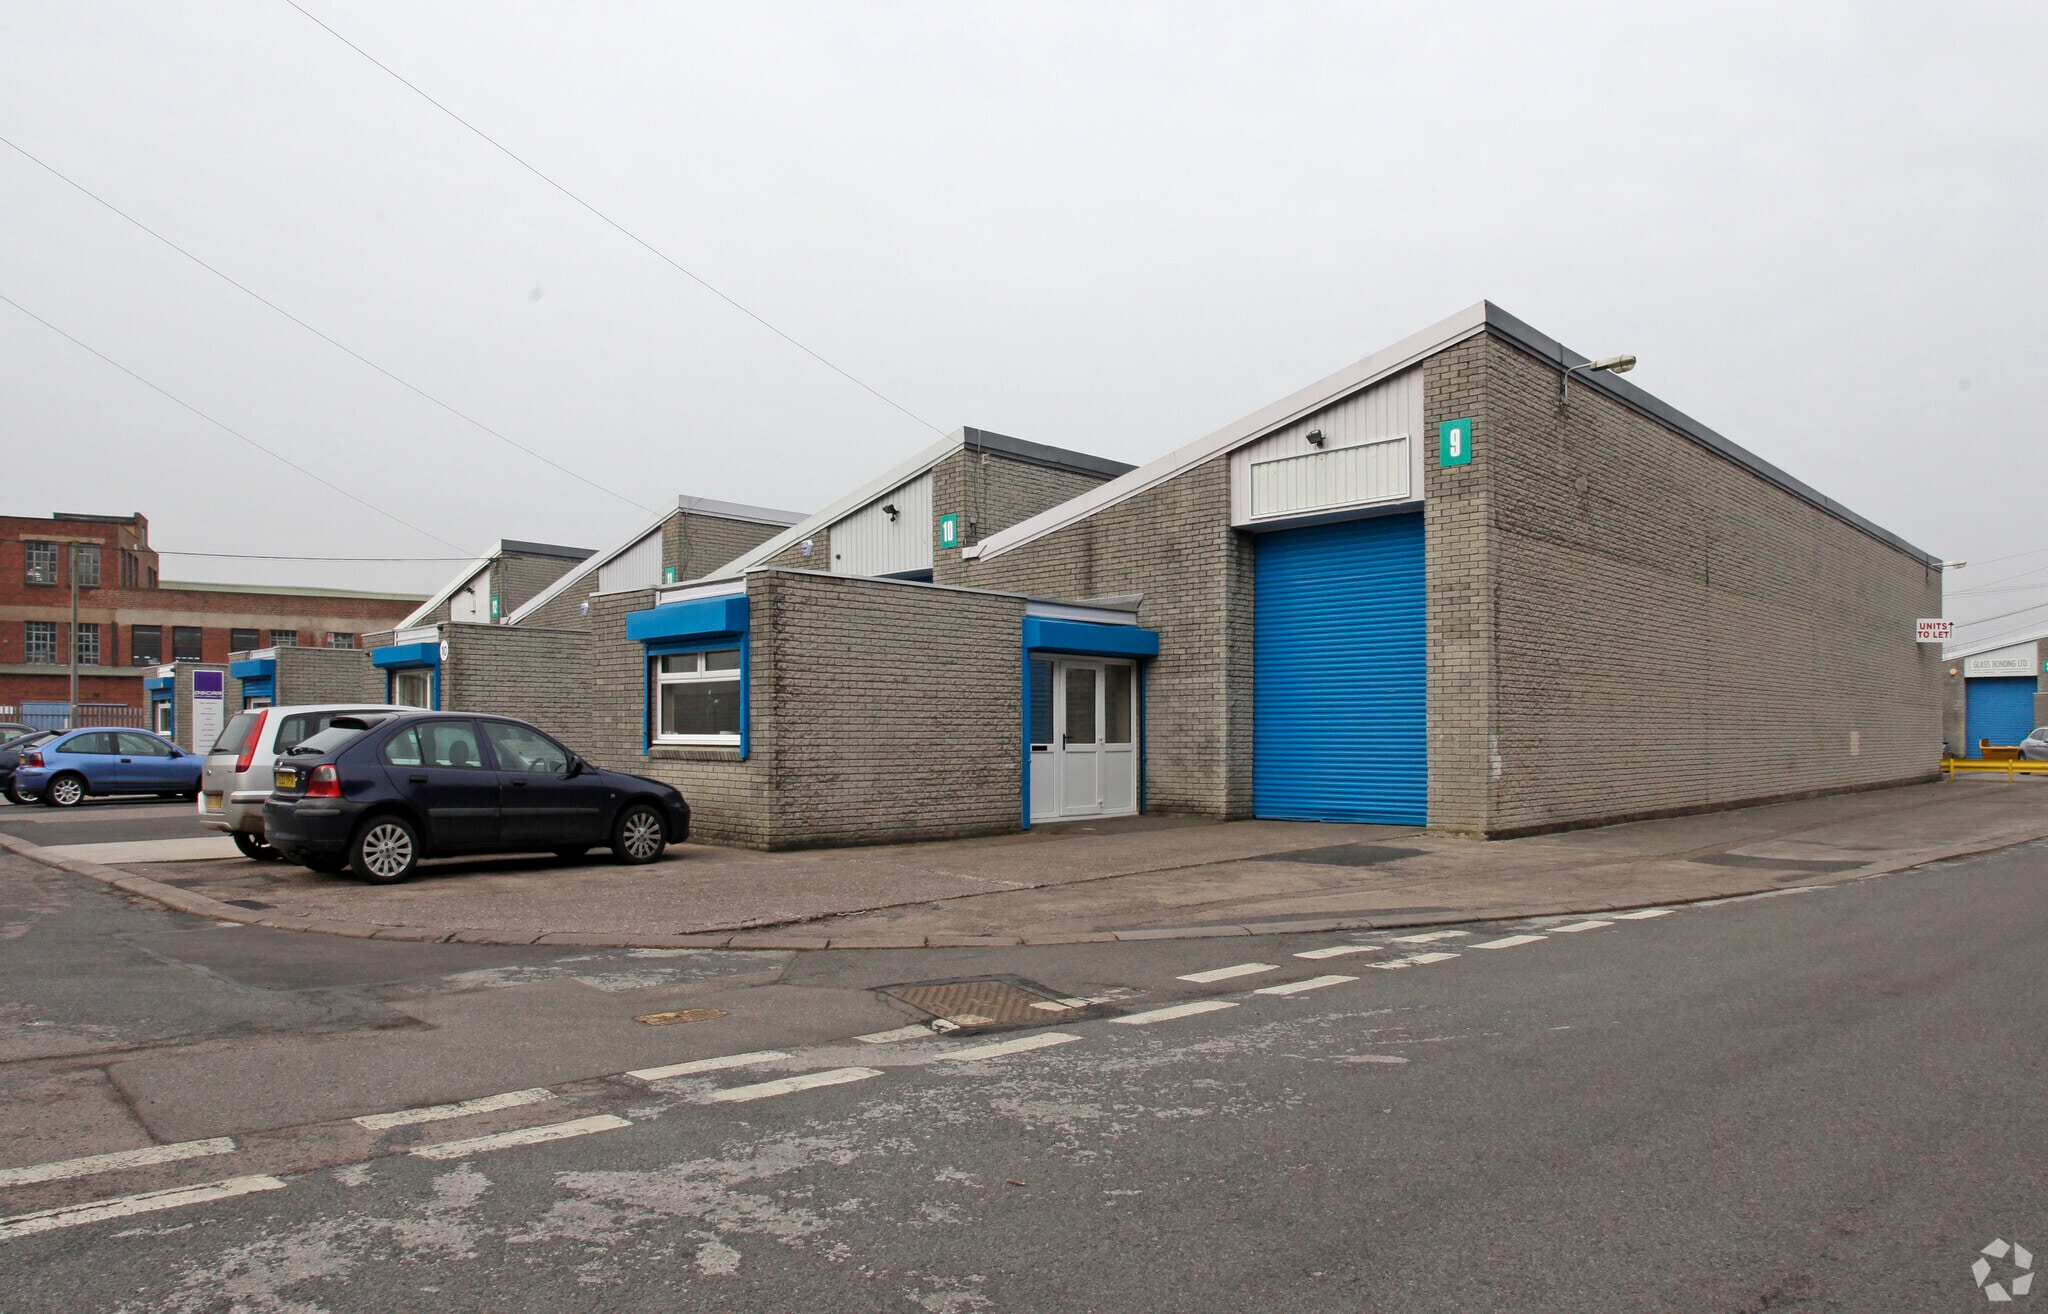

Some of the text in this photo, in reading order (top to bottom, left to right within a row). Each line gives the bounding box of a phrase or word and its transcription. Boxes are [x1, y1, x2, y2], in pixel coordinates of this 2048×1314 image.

[1450, 428, 1461, 457] 9
[943, 520, 954, 542] 10
[1919, 622, 1948, 630] UNITS
[1917, 631, 1950, 639] TO LET
[1973, 659, 2028, 669] GLASS BONDING LTD
